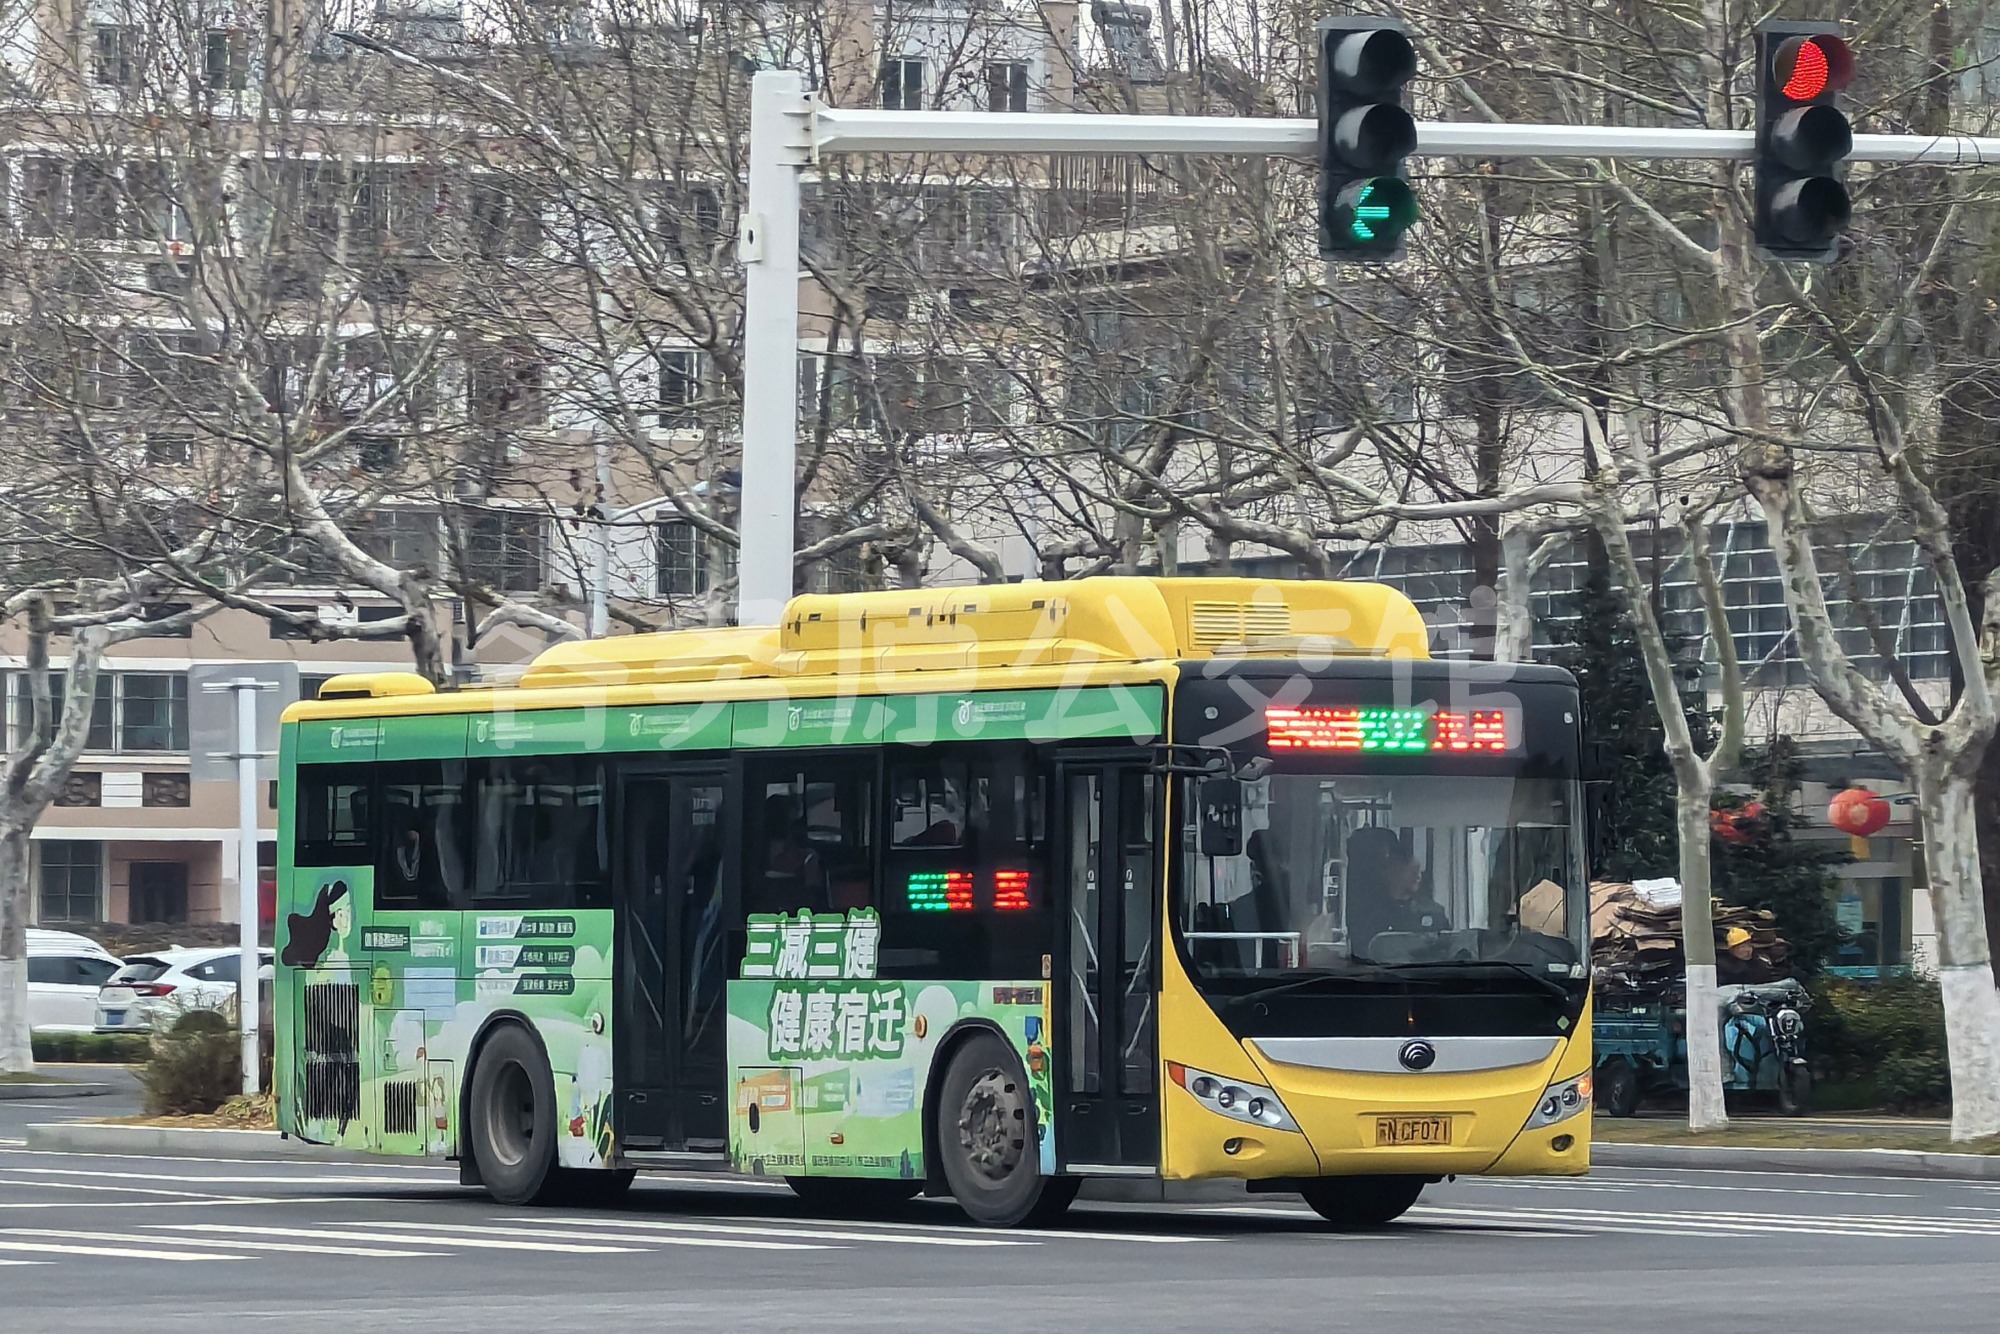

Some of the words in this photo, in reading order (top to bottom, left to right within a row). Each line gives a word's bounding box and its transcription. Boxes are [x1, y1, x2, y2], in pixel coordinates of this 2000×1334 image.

[743, 914, 880, 978] 三减三健
[770, 986, 903, 1054] 健康宿迁
